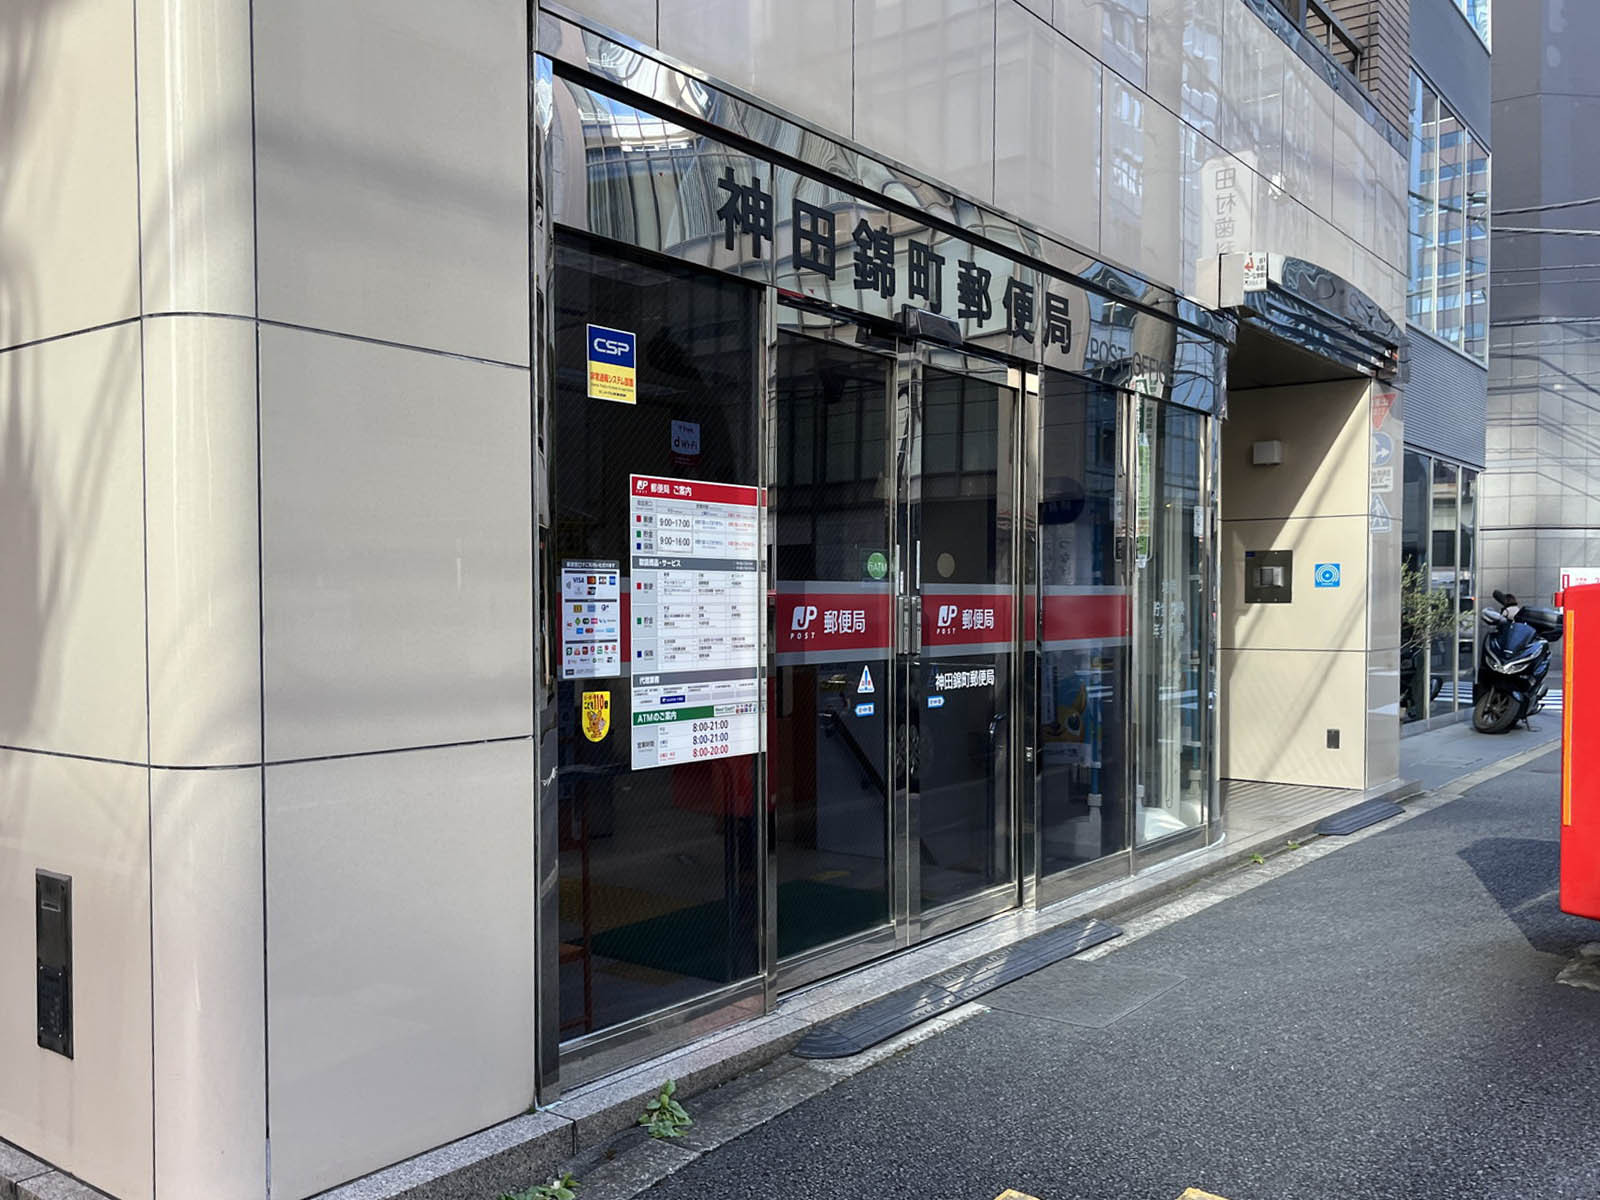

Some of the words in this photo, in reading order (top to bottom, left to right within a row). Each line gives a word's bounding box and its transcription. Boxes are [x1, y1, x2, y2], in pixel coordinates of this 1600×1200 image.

[717, 166, 1072, 355] 神田錦町郵便局
[593, 337, 630, 356] CSP
[1091, 337, 1126, 370] POST
[650, 483, 671, 495] 郵便局
[673, 485, 692, 497] ご案内
[823, 609, 866, 635] 郵便局
[961, 608, 994, 631] 郵便局
[790, 632, 816, 640] POST
[935, 668, 995, 692] 神田錦町郵便局
[637, 711, 677, 723] ATMのご案内
[692, 719, 728, 732] 8:00-21:00
[692, 732, 728, 745] 8:00-21:00
[692, 744, 728, 757] 8:00-20:00
